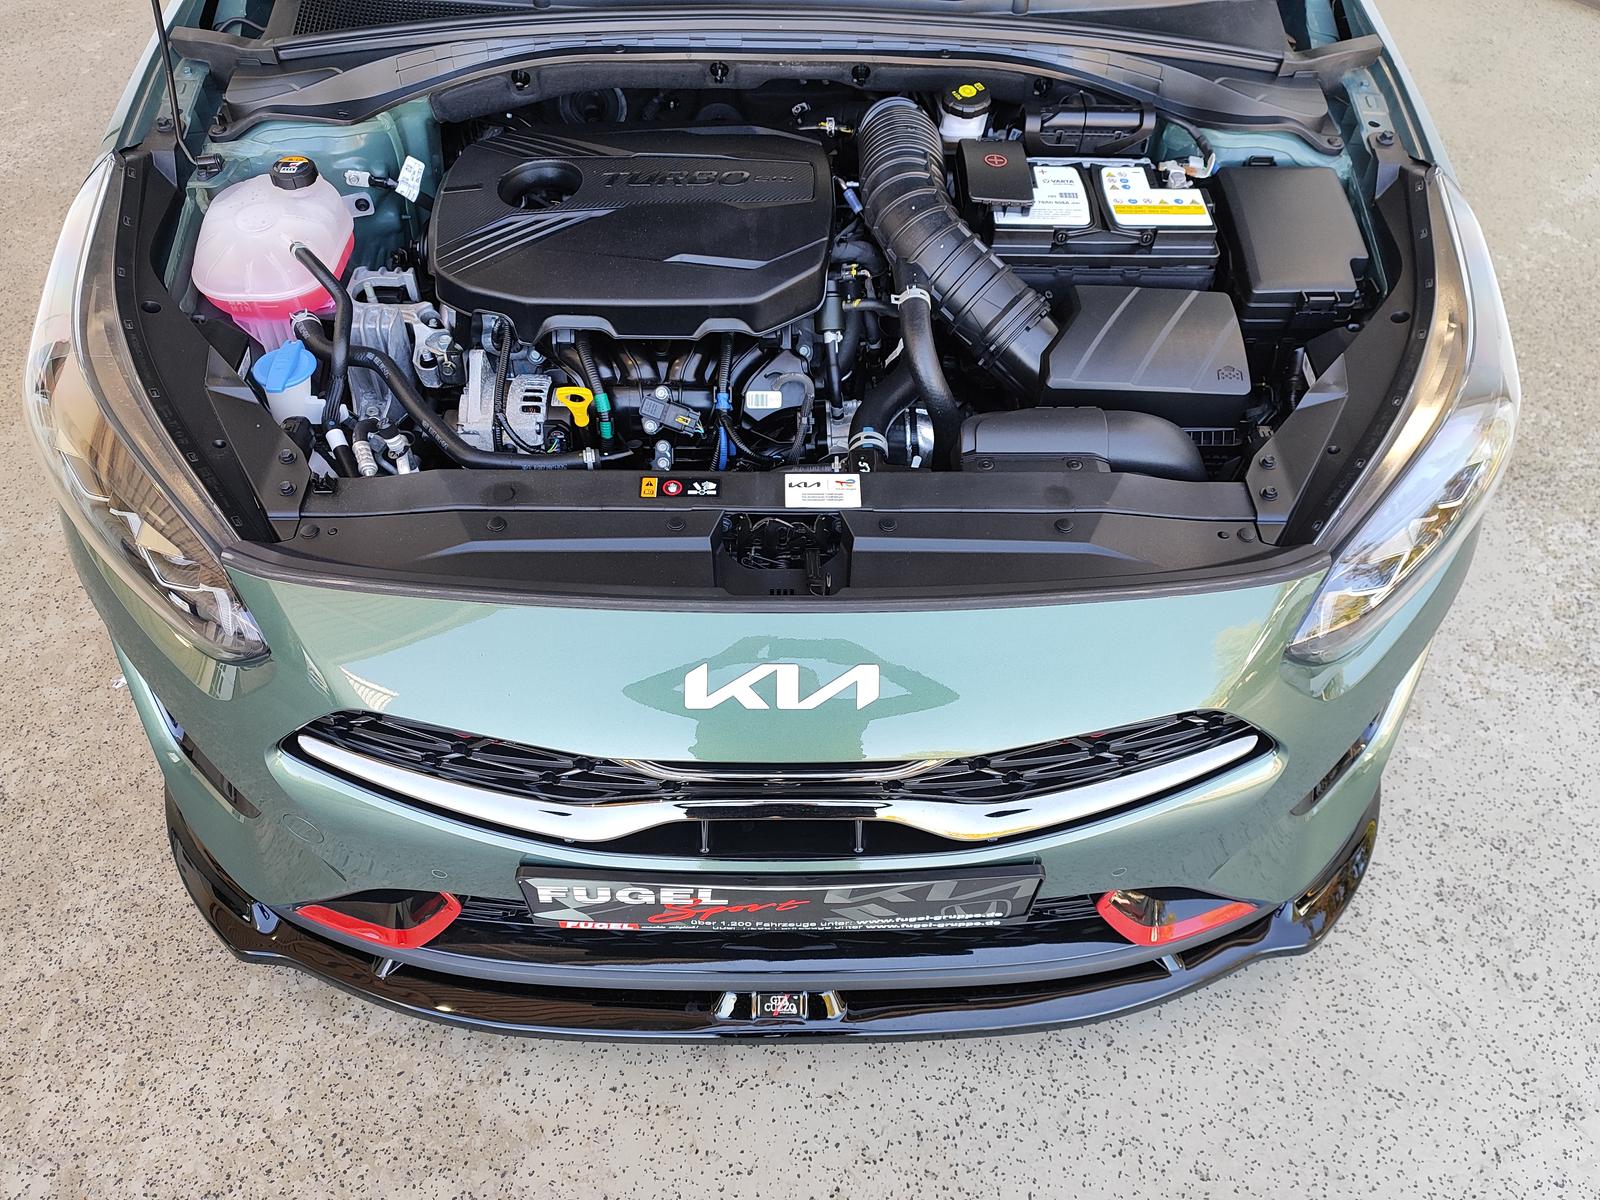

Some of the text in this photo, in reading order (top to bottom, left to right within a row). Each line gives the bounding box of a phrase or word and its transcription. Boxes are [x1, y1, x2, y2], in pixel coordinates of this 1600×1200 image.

[603, 170, 750, 187] TURBO
[684, 662, 880, 711] KIA
[535, 886, 729, 905] FUGEL
[647, 897, 811, 923] Sport
[857, 911, 1004, 925] www.fugel-gruppe.de
[565, 921, 635, 930] FUGEL
